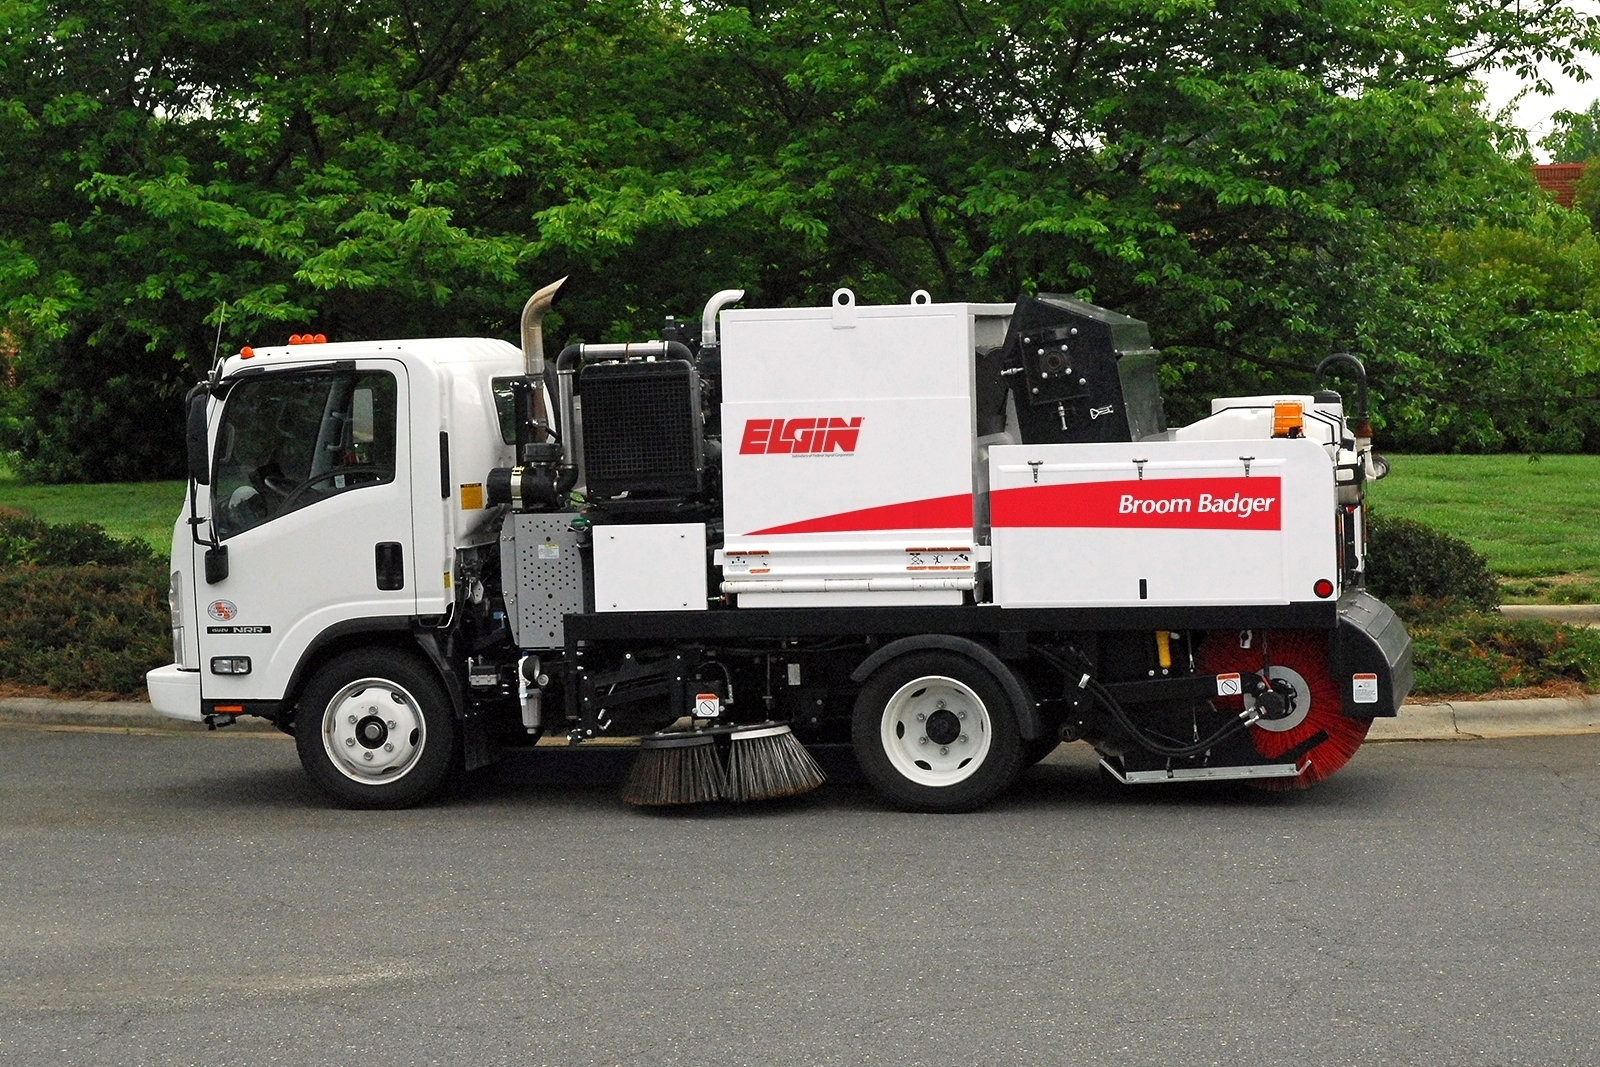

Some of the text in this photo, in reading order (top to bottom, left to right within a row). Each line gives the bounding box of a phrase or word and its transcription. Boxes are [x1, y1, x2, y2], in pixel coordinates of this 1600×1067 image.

[739, 417, 862, 455] ELGIN
[1118, 493, 1275, 518] Broom Badger
